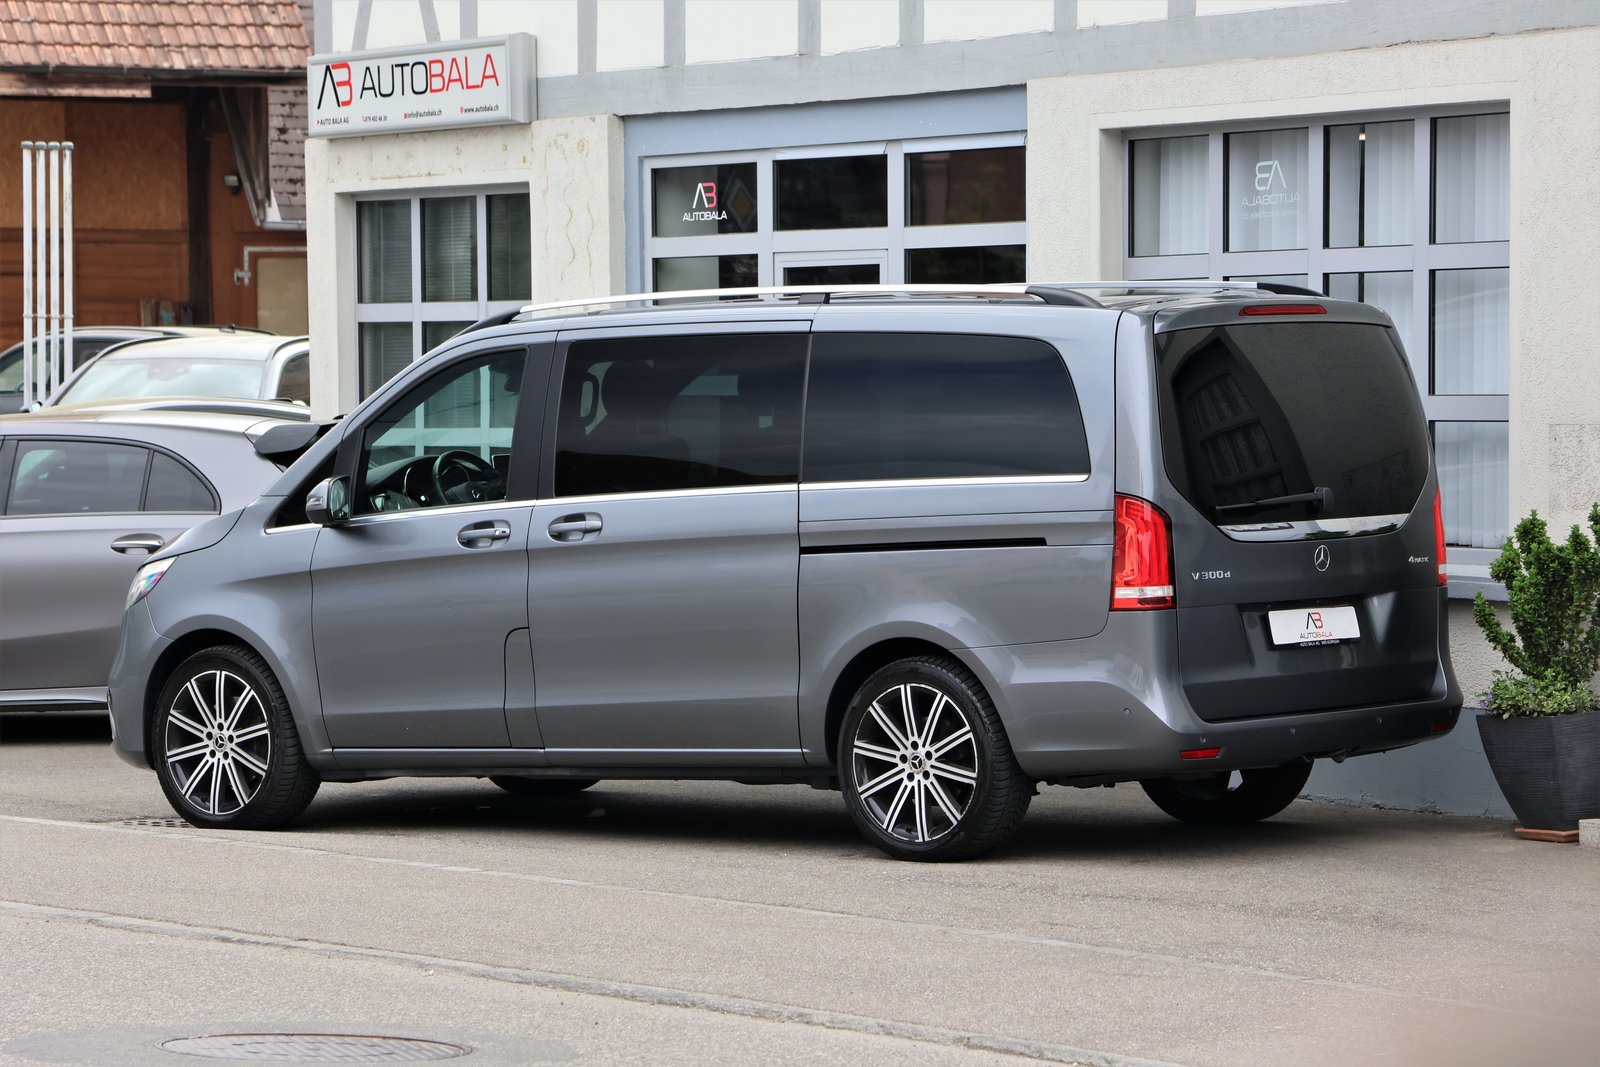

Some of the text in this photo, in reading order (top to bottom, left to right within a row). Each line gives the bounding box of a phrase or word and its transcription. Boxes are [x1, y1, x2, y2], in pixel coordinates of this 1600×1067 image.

[359, 53, 500, 100] AUTOBALA
[317, 62, 353, 109] AB
[407, 108, 442, 119] info@autobala.ch
[464, 103, 499, 114] www.autobala.ch
[320, 118, 331, 126] AUTO
[332, 117, 343, 125] BALA
[692, 182, 717, 209] AB
[682, 210, 728, 222] AUTOBALA
[1306, 611, 1324, 630] AB
[1299, 631, 1334, 639] AUTOBALA
